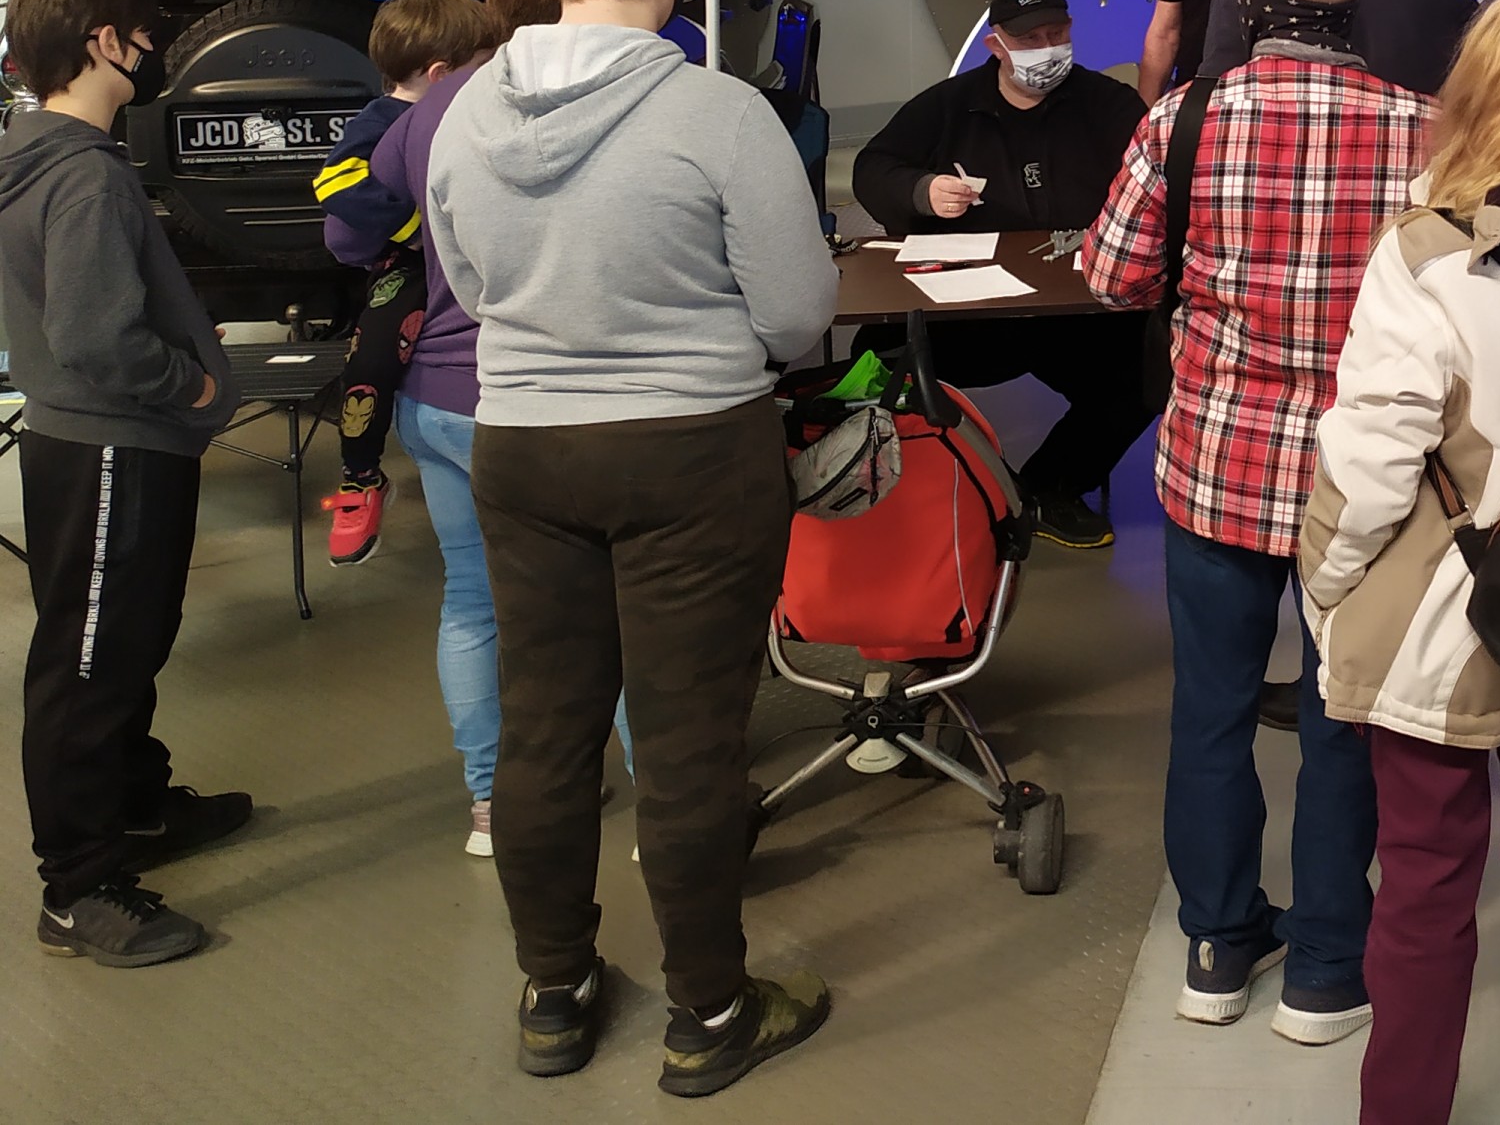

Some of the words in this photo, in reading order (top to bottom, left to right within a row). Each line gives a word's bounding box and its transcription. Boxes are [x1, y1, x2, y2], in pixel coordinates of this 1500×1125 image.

[189, 120, 240, 147] JCD
[286, 117, 322, 144] St.
[328, 116, 355, 142] S
[100, 470, 113, 490] KEEP
[97, 502, 111, 526] BRKLN
[90, 570, 104, 589] KEEP
